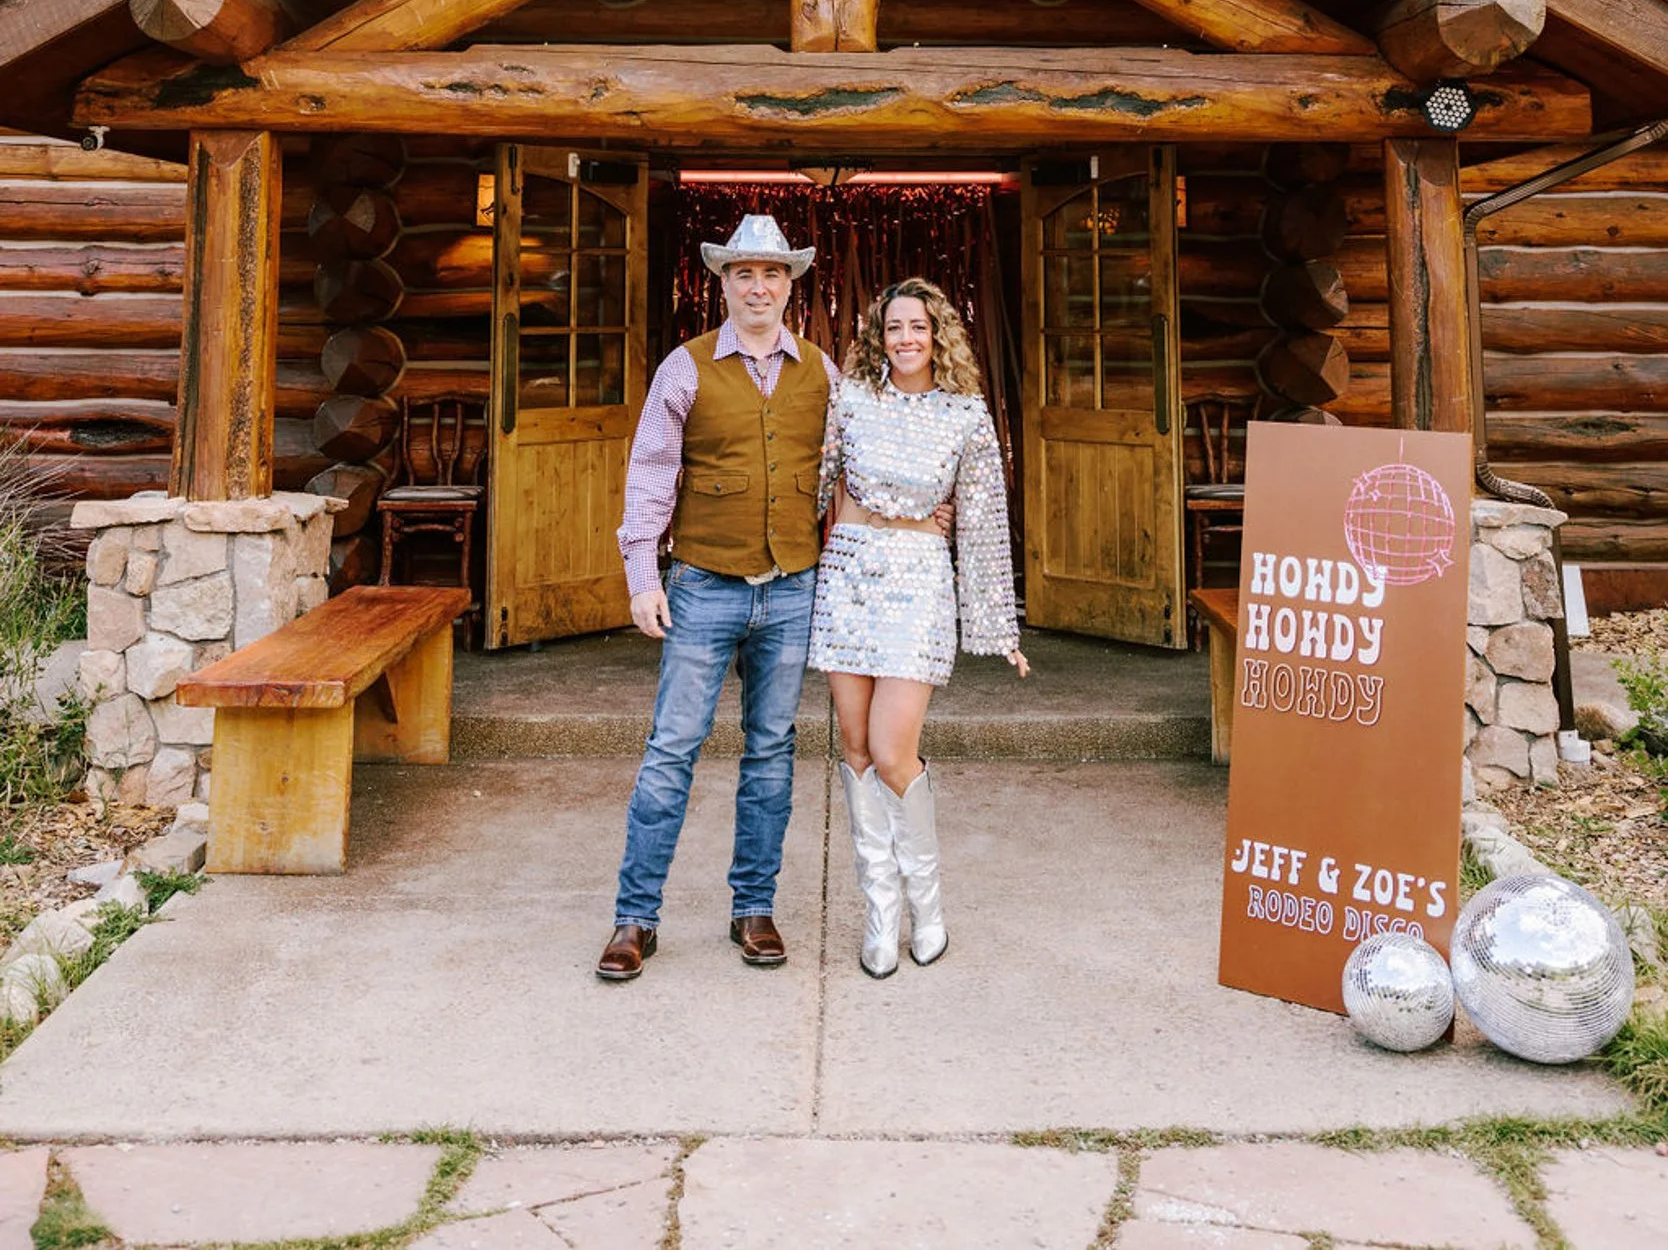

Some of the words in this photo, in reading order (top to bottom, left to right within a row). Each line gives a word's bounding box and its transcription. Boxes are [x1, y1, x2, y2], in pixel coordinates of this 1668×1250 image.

[1250, 552, 1388, 608] HOWDY
[1245, 604, 1384, 665] HOWDY
[1241, 658, 1384, 725] HOWDY
[1231, 839, 1307, 885] JEFF
[1318, 857, 1342, 894] &
[1353, 863, 1447, 917] ZOE'S
[1247, 885, 1334, 935] RODEO
